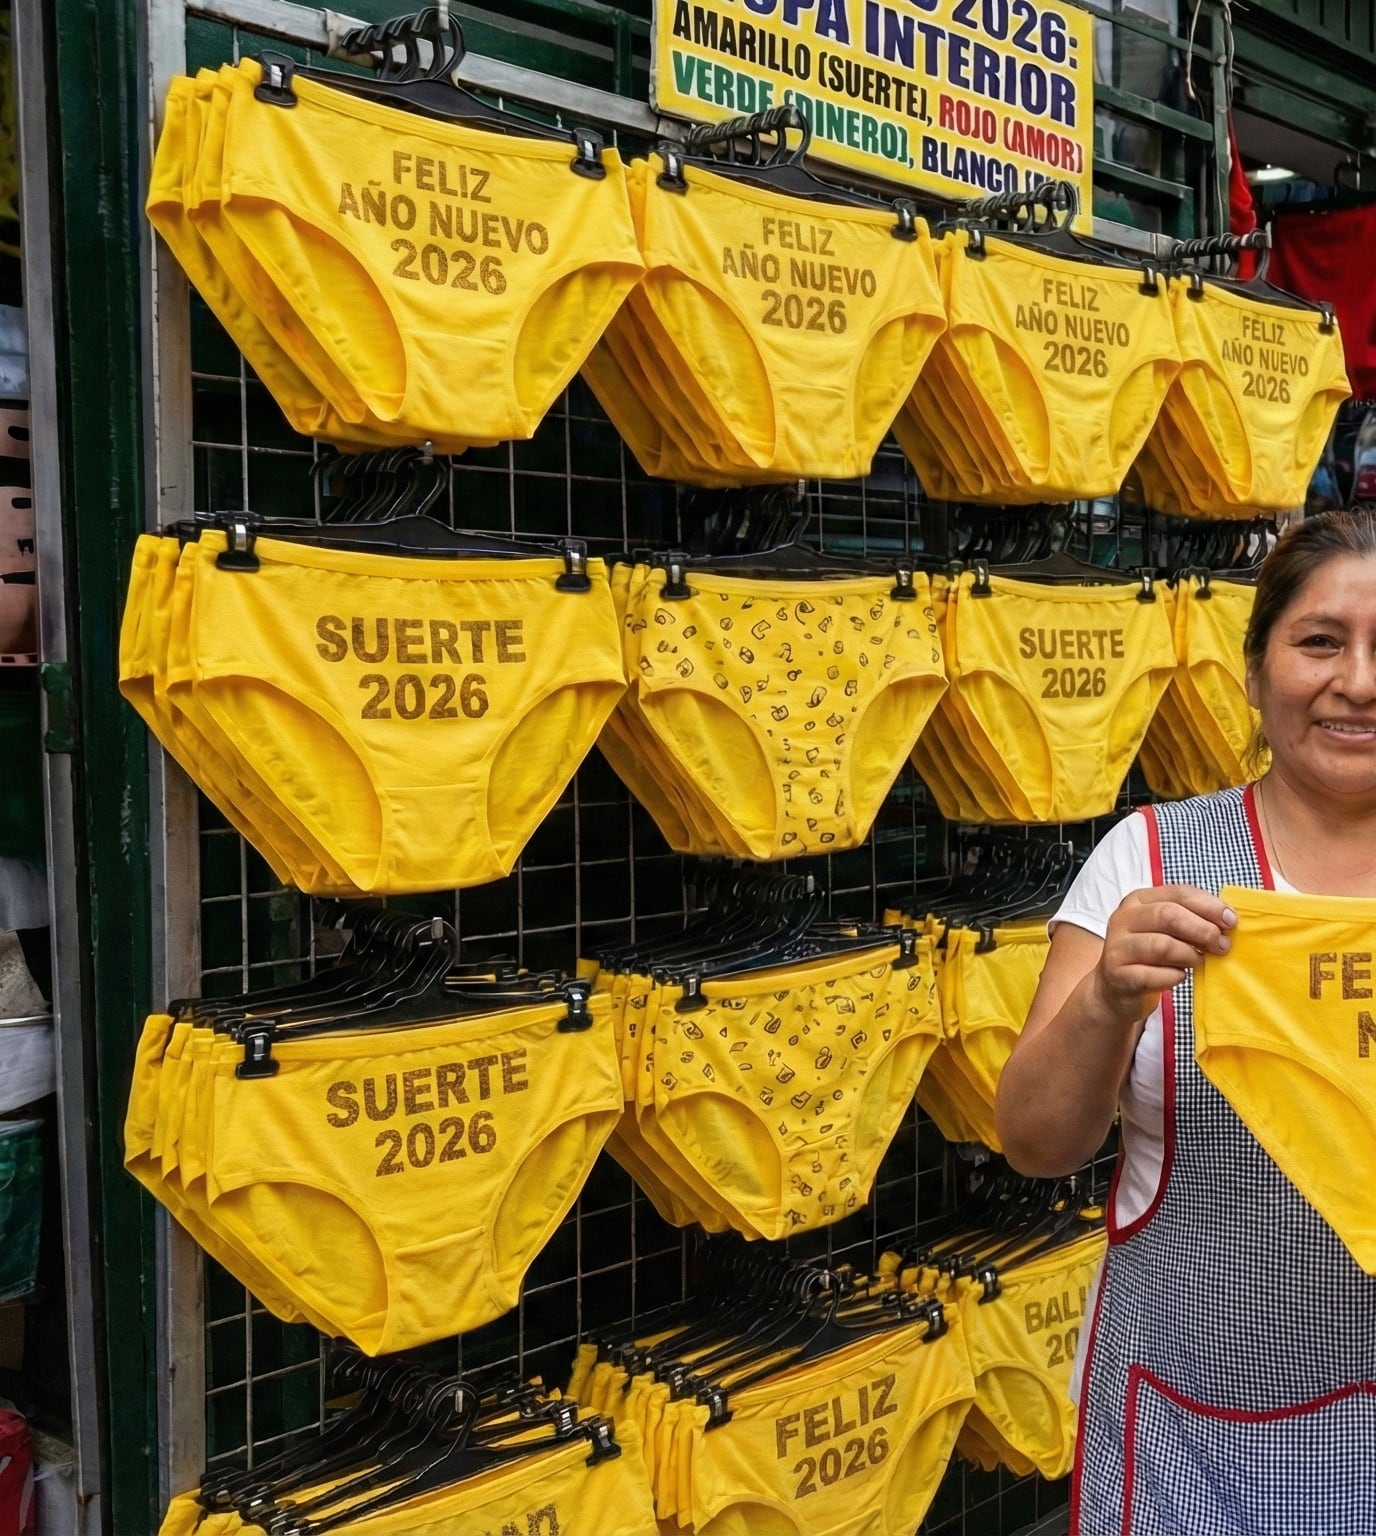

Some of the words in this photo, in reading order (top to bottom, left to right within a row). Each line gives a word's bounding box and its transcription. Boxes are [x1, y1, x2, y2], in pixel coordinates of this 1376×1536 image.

[673, 1, 811, 80] AMARILLO
[939, 94, 996, 144] ROJO
[866, 1, 1075, 127] INTERIOR
[673, 51, 774, 113] VERDE
[922, 136, 1018, 192] BLANCO
[393, 150, 490, 202] FELIZ
[339, 180, 416, 231] AÑO
[429, 201, 548, 256] NUEVO
[762, 216, 834, 257] FELIZ
[391, 238, 506, 294] 2026
[722, 244, 778, 281] AÑO
[790, 258, 875, 298] NUEVO
[761, 292, 847, 334] 2026
[1042, 278, 1100, 312] FELIZ
[1016, 301, 1058, 334] AÑO
[1064, 314, 1129, 348] NUEVO
[1242, 314, 1286, 347] FELIZ
[1042, 341, 1108, 378] 2026
[1221, 336, 1255, 366] AÑO
[1259, 346, 1309, 378] NUEVO
[1241, 371, 1291, 404] 2026
[316, 615, 525, 664] SUERTE
[1019, 627, 1124, 661] SUERTE
[360, 673, 489, 720] 2026
[1041, 668, 1106, 699] 2026
[326, 1048, 529, 1128] SUERTE
[374, 1110, 496, 1177] 2026
[775, 1373, 897, 1459] FELIZ
[794, 1427, 888, 1499] 2026
